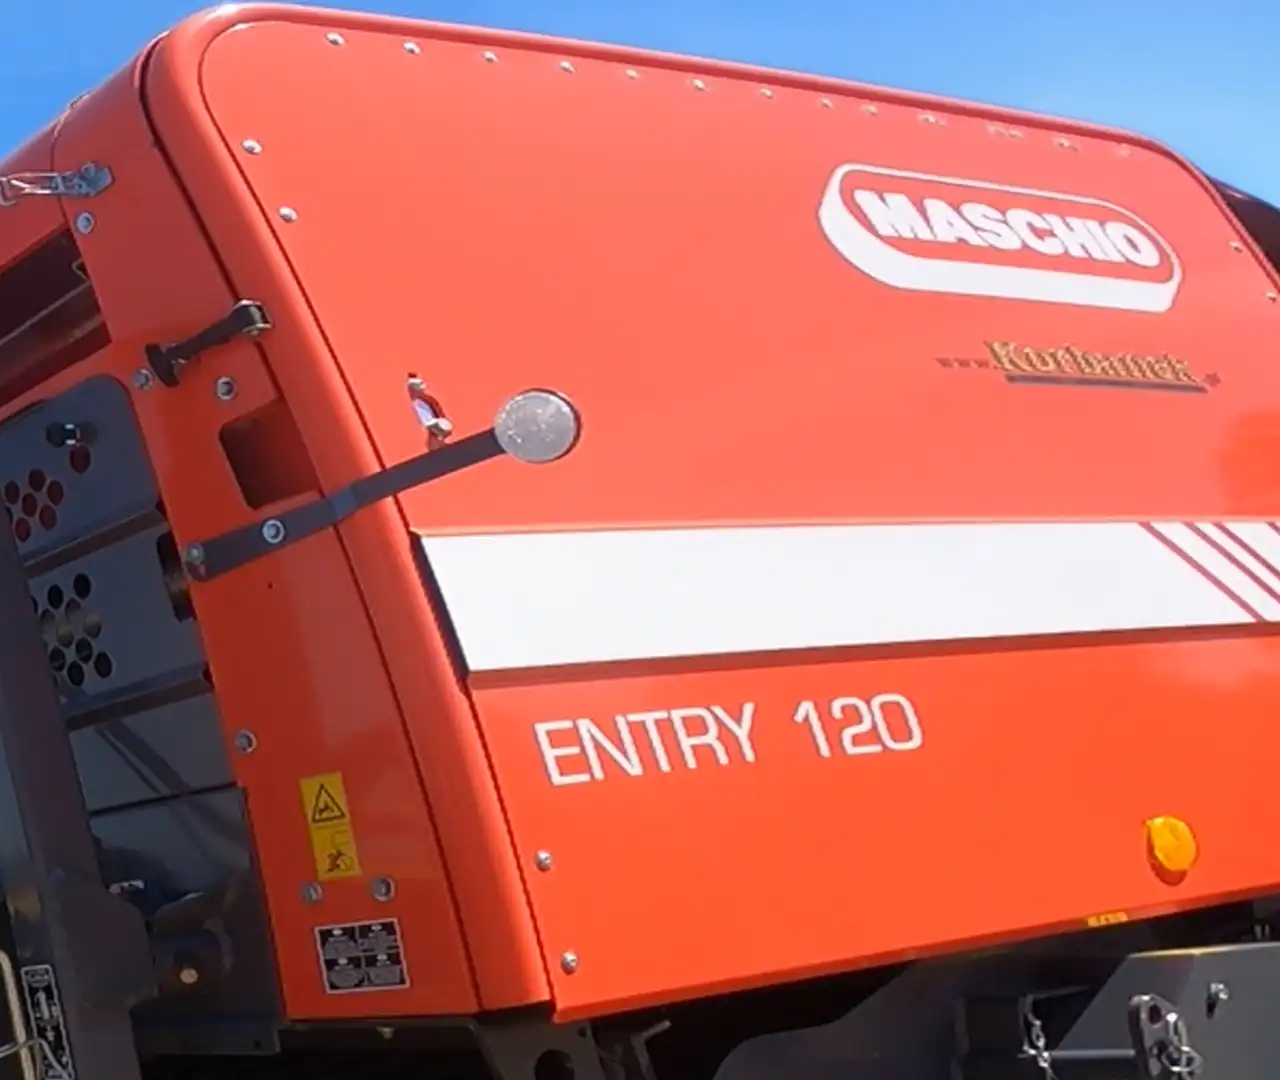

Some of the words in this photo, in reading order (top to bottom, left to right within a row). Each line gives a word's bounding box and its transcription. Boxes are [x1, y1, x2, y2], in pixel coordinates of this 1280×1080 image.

[853, 189, 1160, 267] MASCHIO
[534, 702, 756, 786] ENTRY
[794, 693, 923, 758] 120
